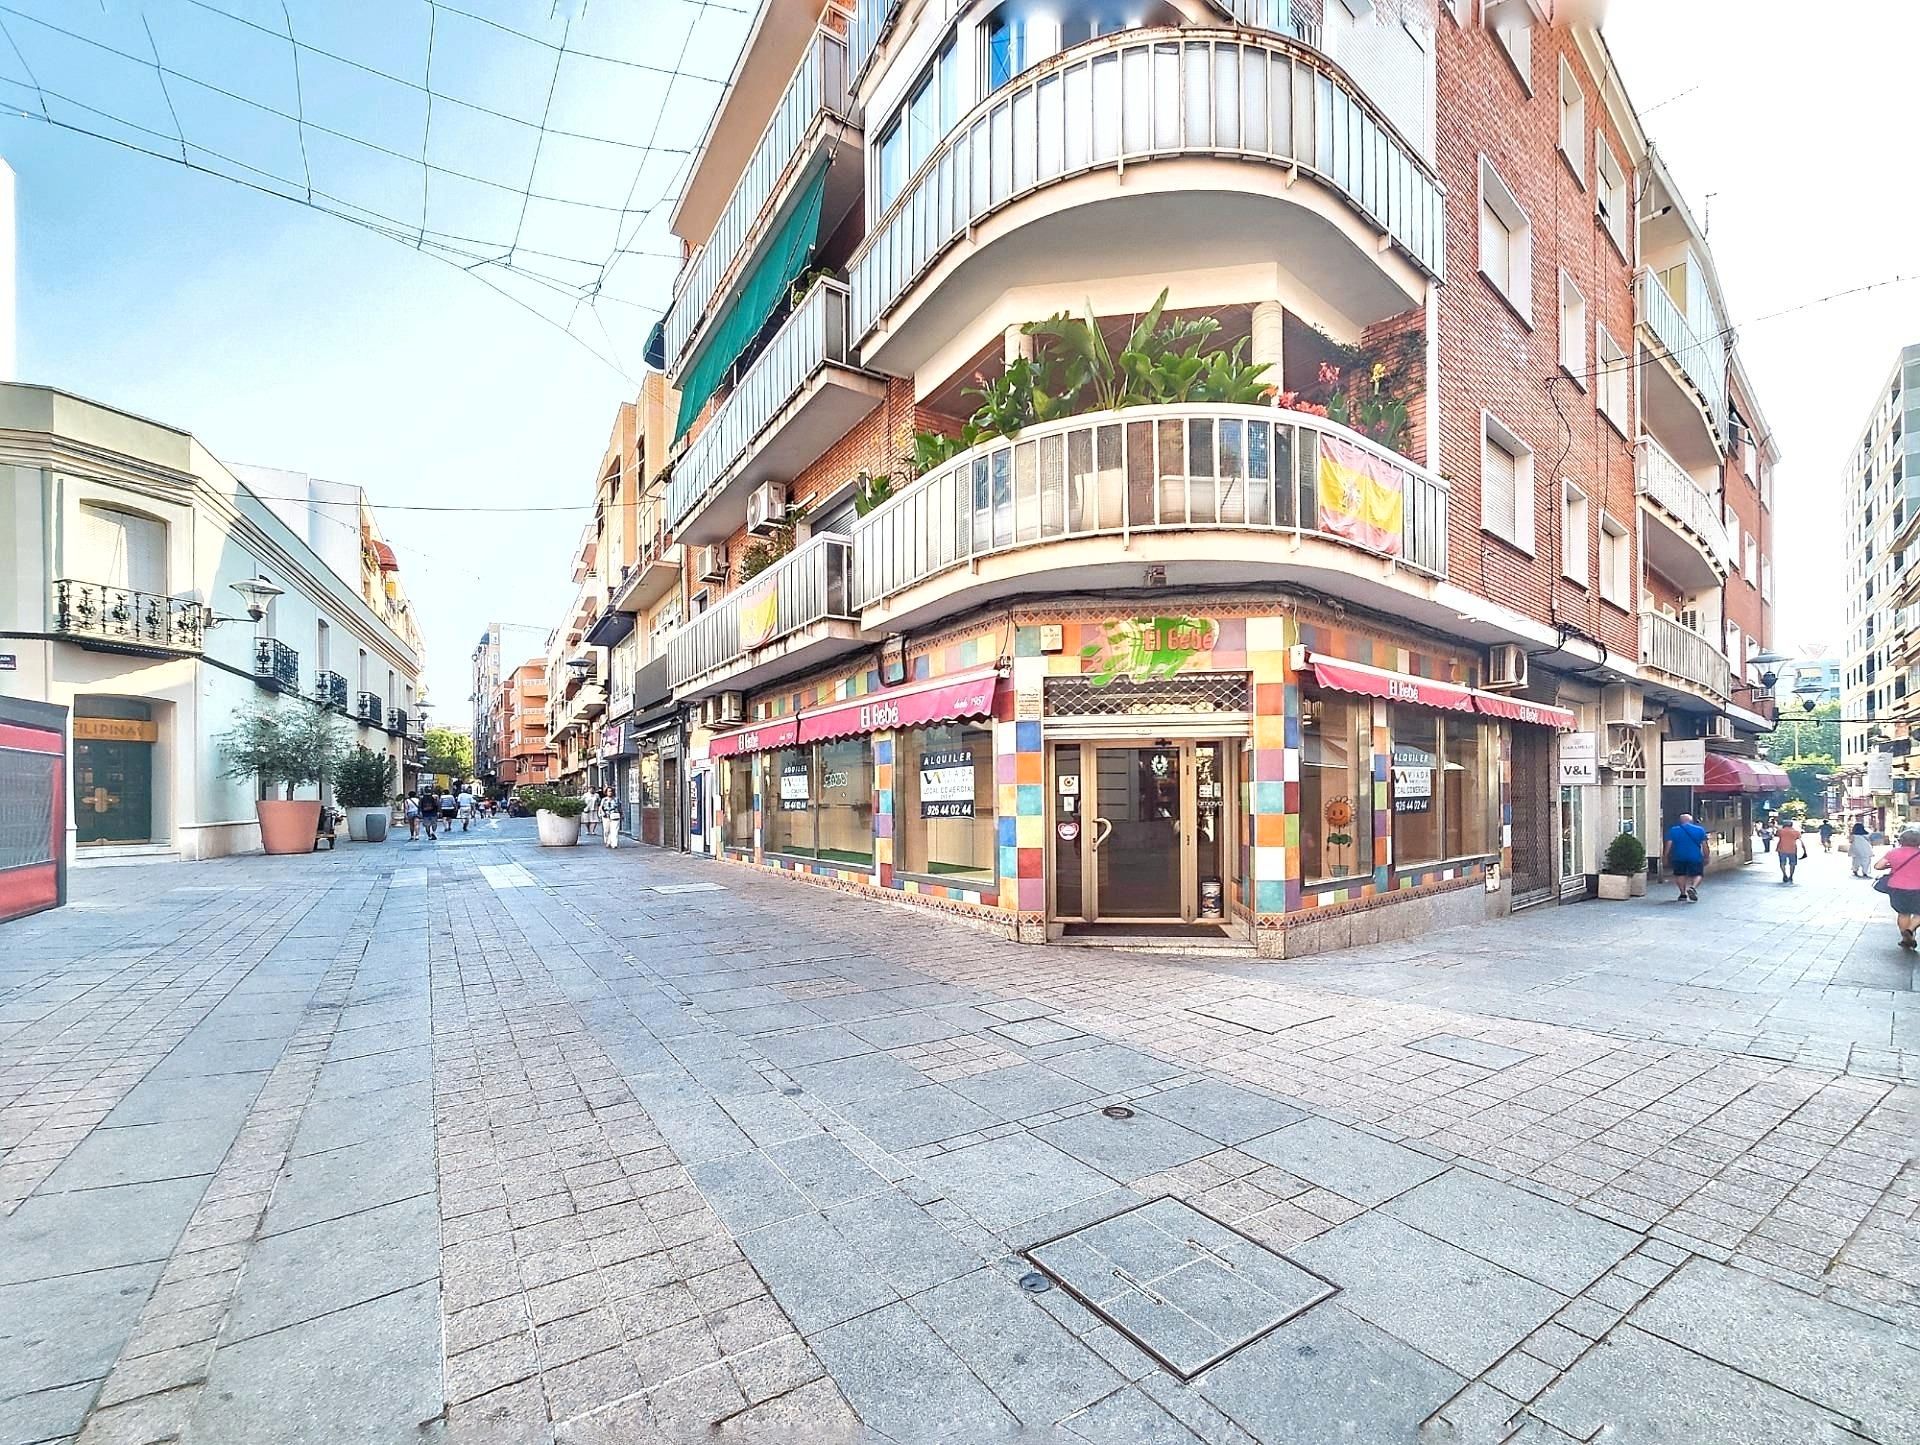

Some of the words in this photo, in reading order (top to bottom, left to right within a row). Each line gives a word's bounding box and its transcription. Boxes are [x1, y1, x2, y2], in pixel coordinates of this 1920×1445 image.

[1144, 628, 1161, 651] El
[1389, 680, 1398, 697] El
[1399, 679, 1419, 700] Bebé
[861, 706, 870, 728] El
[872, 699, 899, 725] Bebé
[1520, 705, 1526, 721] El
[738, 734, 745, 750] El
[923, 752, 971, 766] ALQUILER
[1394, 753, 1428, 762] ALQUILER
[1564, 765, 1592, 776] V&L
[927, 804, 940, 815] 926
[940, 804, 950, 815] 44
[951, 804, 960, 815] 02
[961, 803, 971, 815] 44
[1407, 800, 1414, 810] 44
[1421, 800, 1427, 809] 44
